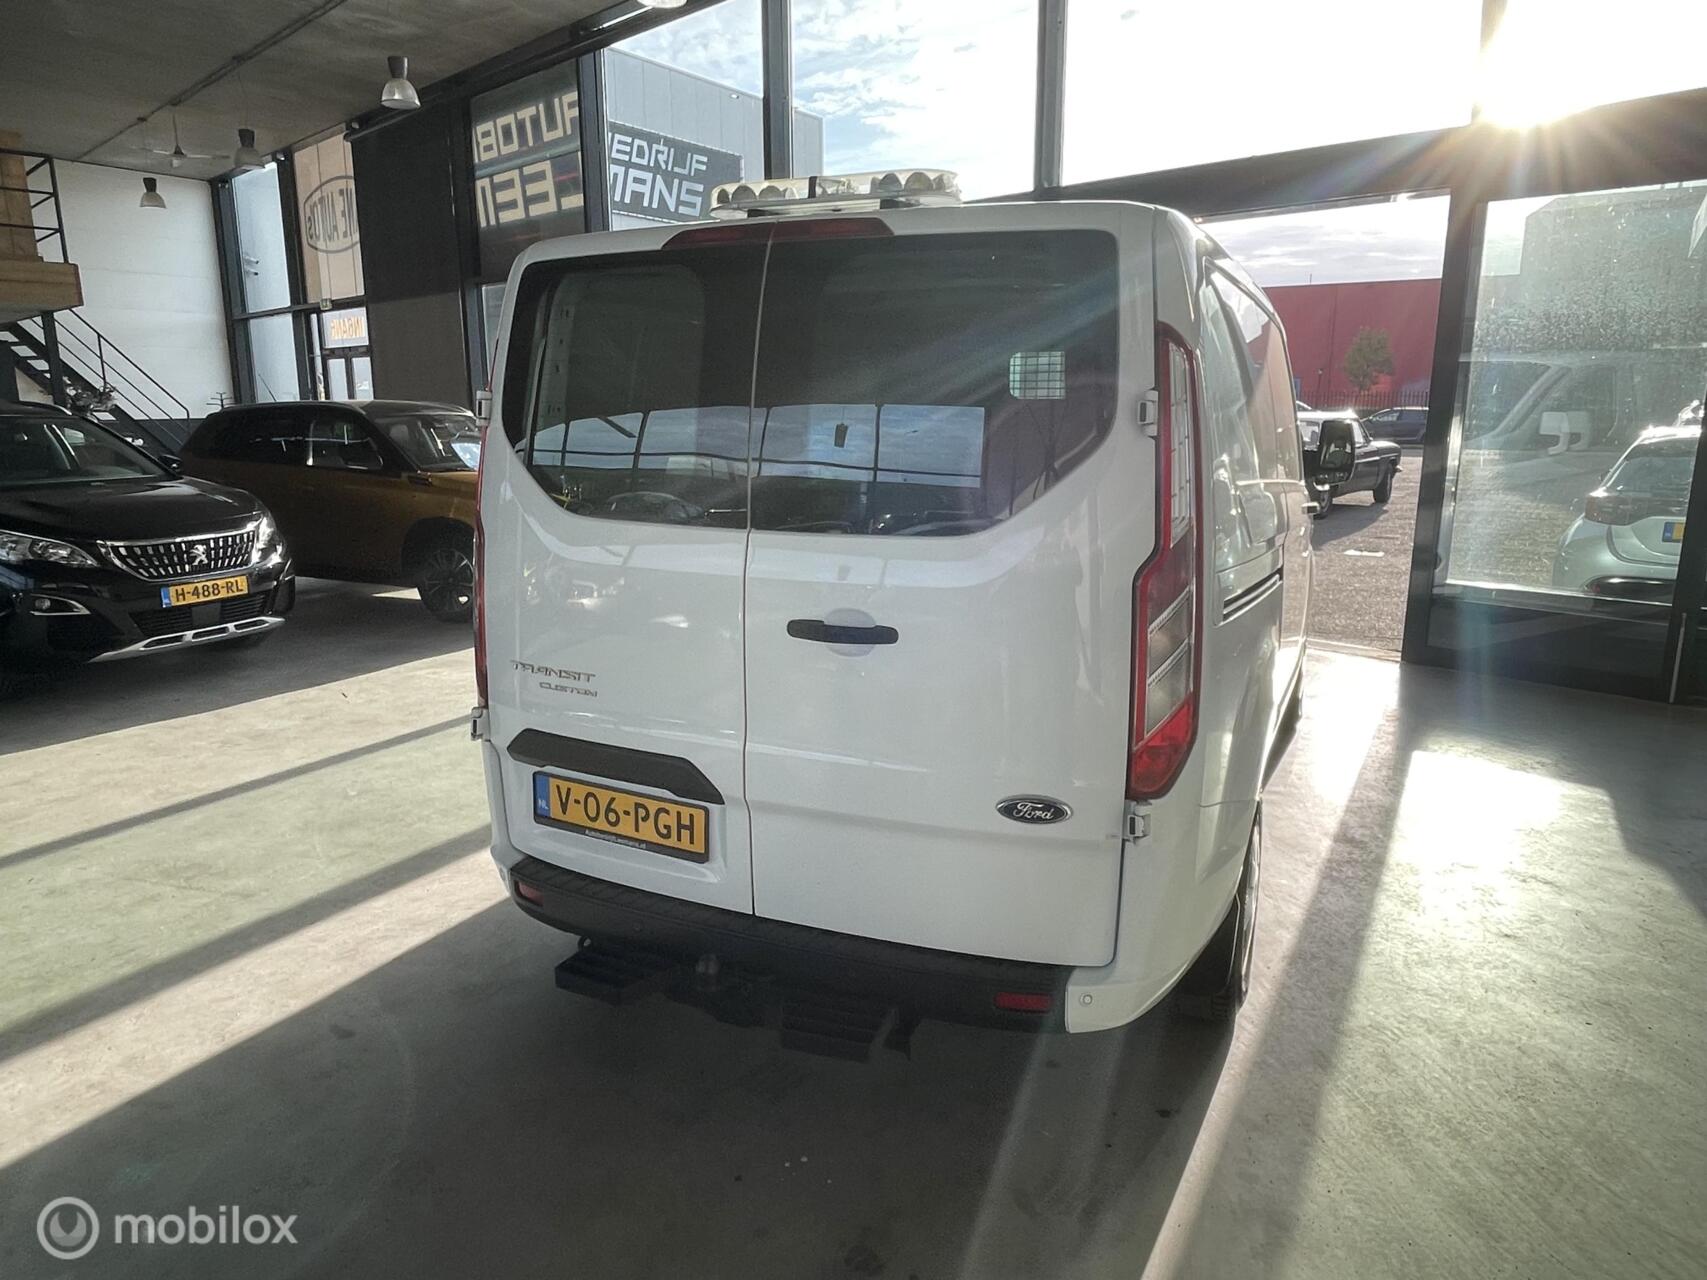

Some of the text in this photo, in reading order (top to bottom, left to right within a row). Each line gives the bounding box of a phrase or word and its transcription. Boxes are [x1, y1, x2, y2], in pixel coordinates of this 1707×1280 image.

[608, 132, 708, 177] EDRIJF
[175, 579, 244, 602] H-488-RL
[509, 660, 597, 682] TRANSIT
[555, 784, 695, 845] V-06-PGH
[1012, 801, 1055, 820] Ford
